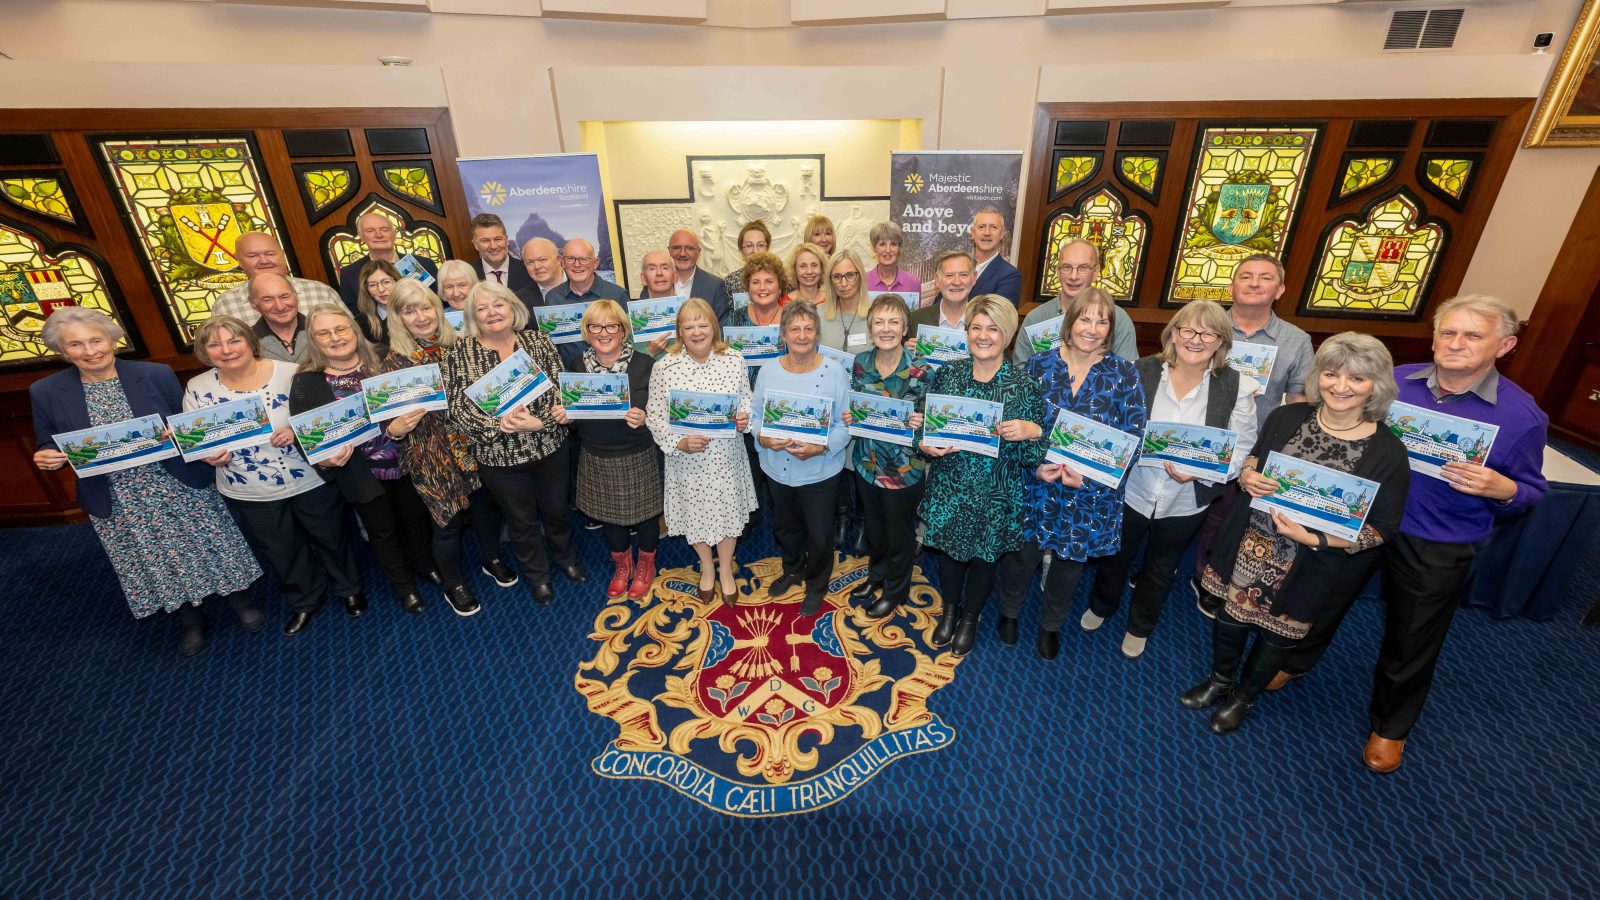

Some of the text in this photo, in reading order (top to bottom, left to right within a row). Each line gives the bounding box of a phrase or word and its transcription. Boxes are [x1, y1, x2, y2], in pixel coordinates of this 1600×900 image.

[929, 173, 971, 183] Majestic
[509, 183, 587, 197] Aberdeenshire
[928, 183, 1003, 194] Aberdeenshire
[558, 193, 589, 201] Scotland
[902, 203, 953, 218] Above
[902, 219, 974, 237] and beyo
[669, 581, 685, 591] VIS
[769, 679, 782, 692] D
[737, 705, 751, 717] W
[802, 700, 815, 712] G
[600, 750, 717, 803] CONCORDIA
[788, 723, 947, 809] TRANQUILLITAS
